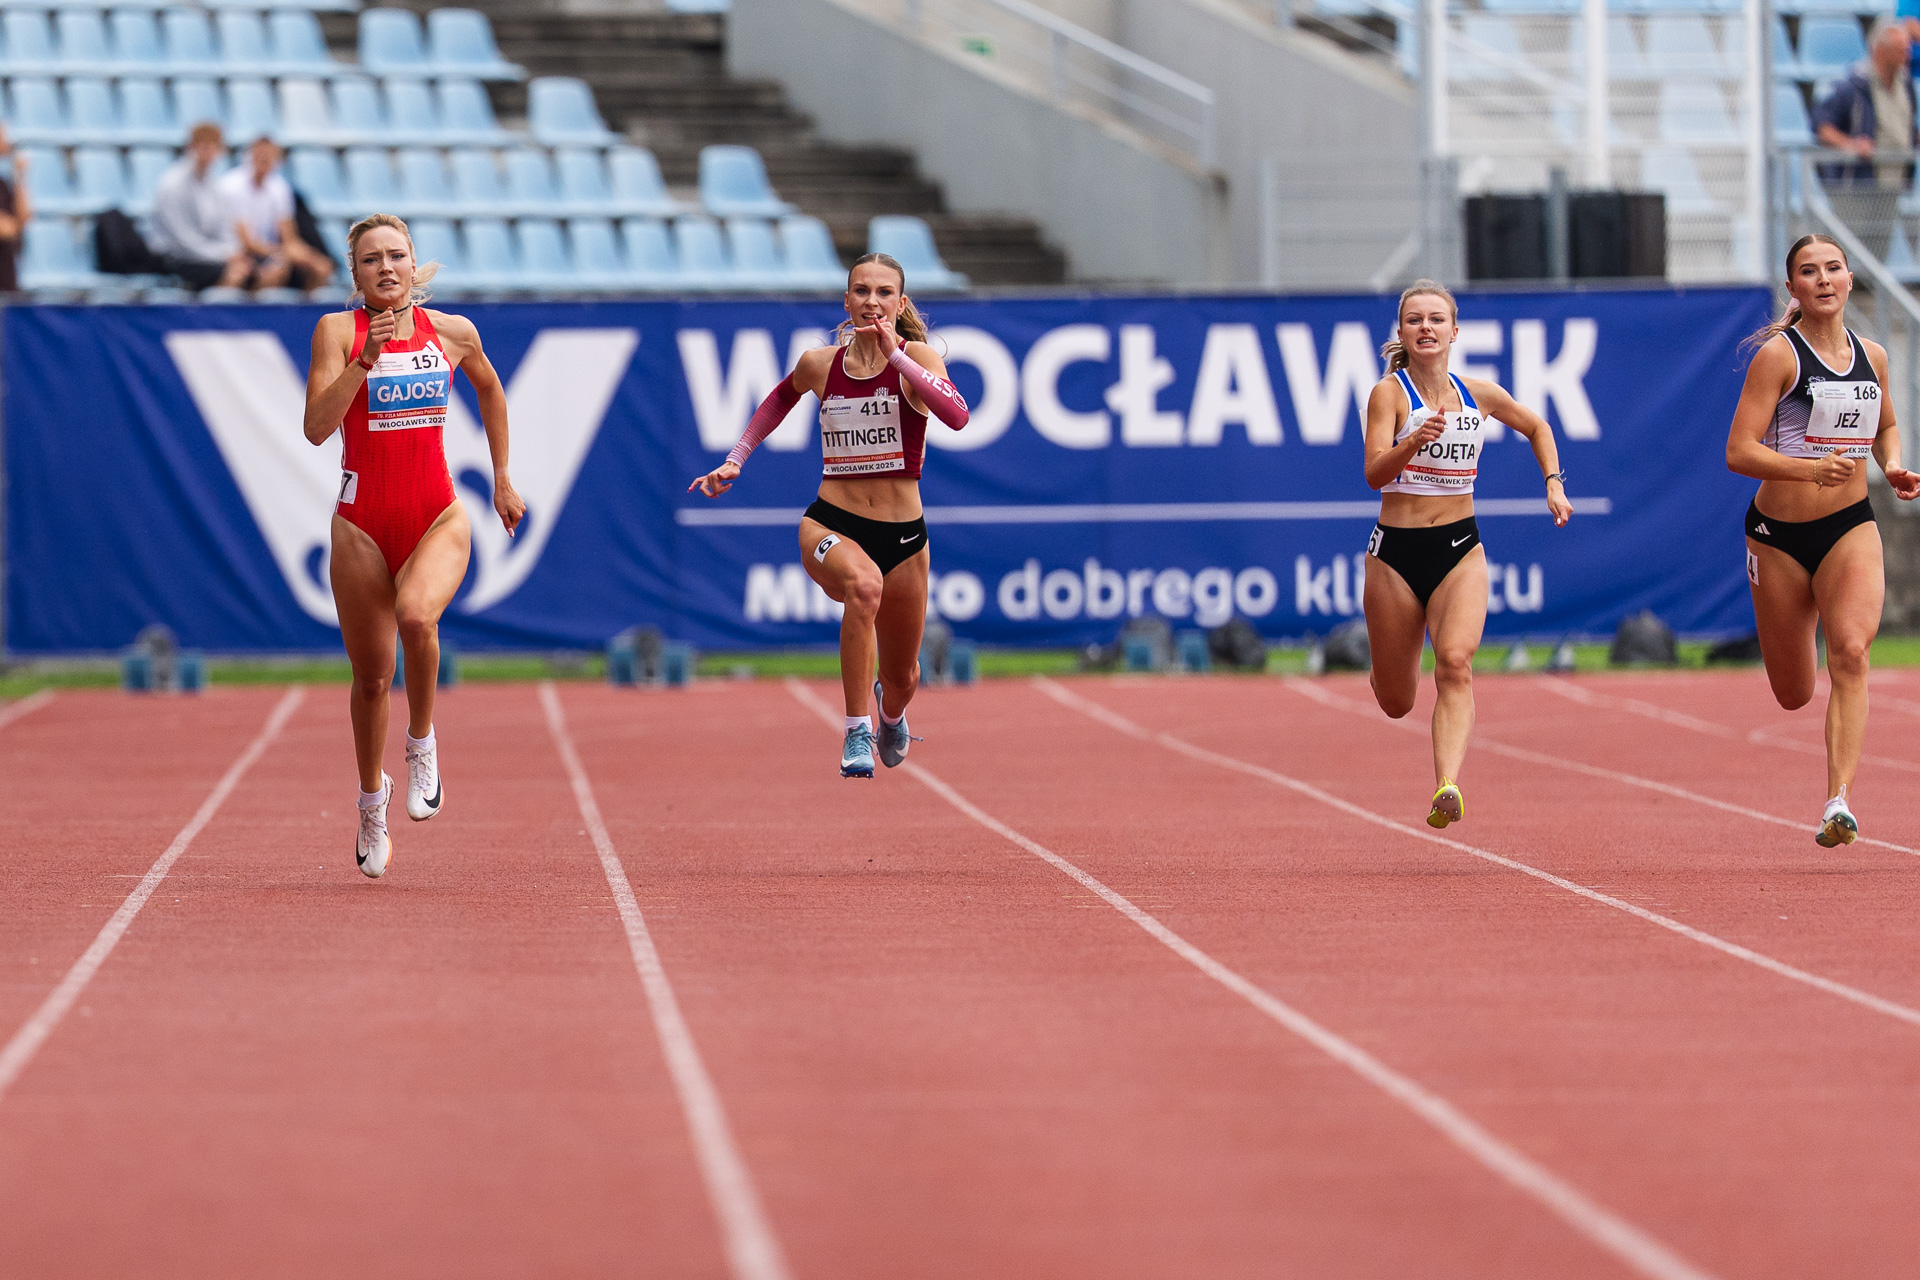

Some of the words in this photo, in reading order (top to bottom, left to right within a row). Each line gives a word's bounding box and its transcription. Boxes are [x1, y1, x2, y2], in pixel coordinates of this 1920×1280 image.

[412, 355, 438, 369] 157
[377, 380, 445, 403] GAJOSZ
[675, 317, 1600, 452] WOCŁAWEK
[1853, 386, 1877, 400] 168
[860, 401, 891, 416] 411
[378, 418, 427, 429] WŁOCŁAWEK
[1456, 416, 1479, 431] 159
[1834, 408, 1860, 428] JEŻ
[823, 426, 898, 447] TITTINGER
[1417, 442, 1475, 463] POJĘTA
[1812, 445, 1857, 454] WŁOCEK
[831, 464, 874, 472] WŁOCŁAWEK
[341, 473, 353, 499] 7
[1412, 474, 1460, 485] WŁOCŁAWEK
[819, 538, 833, 554] 6
[1368, 528, 1379, 553] 5
[1748, 555, 1755, 580] 4
[997, 556, 1278, 628] dobrego
